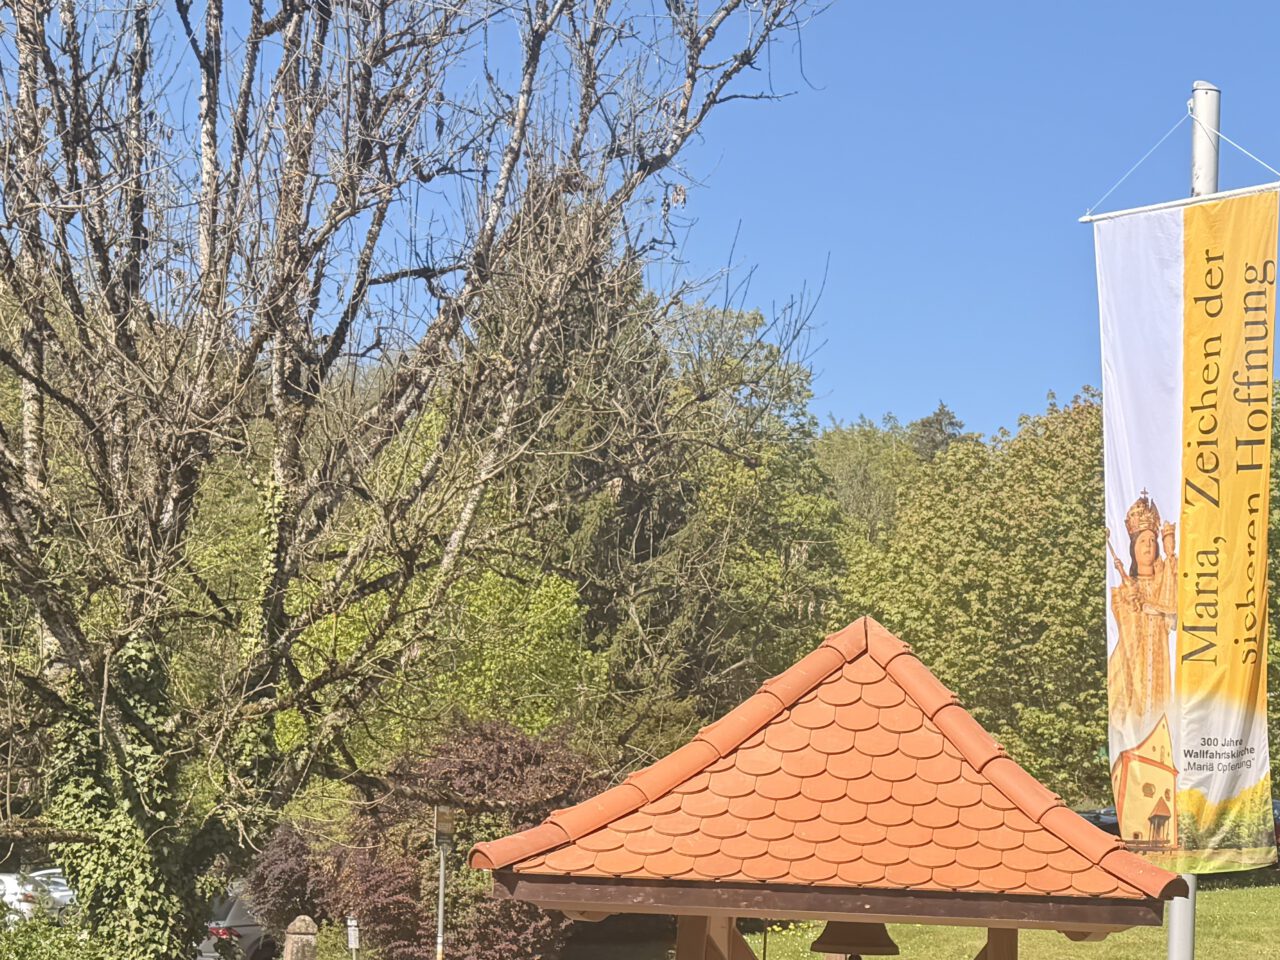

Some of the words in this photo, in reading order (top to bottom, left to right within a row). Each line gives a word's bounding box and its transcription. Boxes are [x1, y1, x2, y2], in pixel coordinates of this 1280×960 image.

[1193, 249, 1225, 319] der
[1185, 333, 1221, 509] Zeichen
[1232, 259, 1276, 475] Hoffnung
[1181, 536, 1227, 666] Maria,
[1200, 737, 1219, 747] 300
[1221, 737, 1243, 747] Jahre
